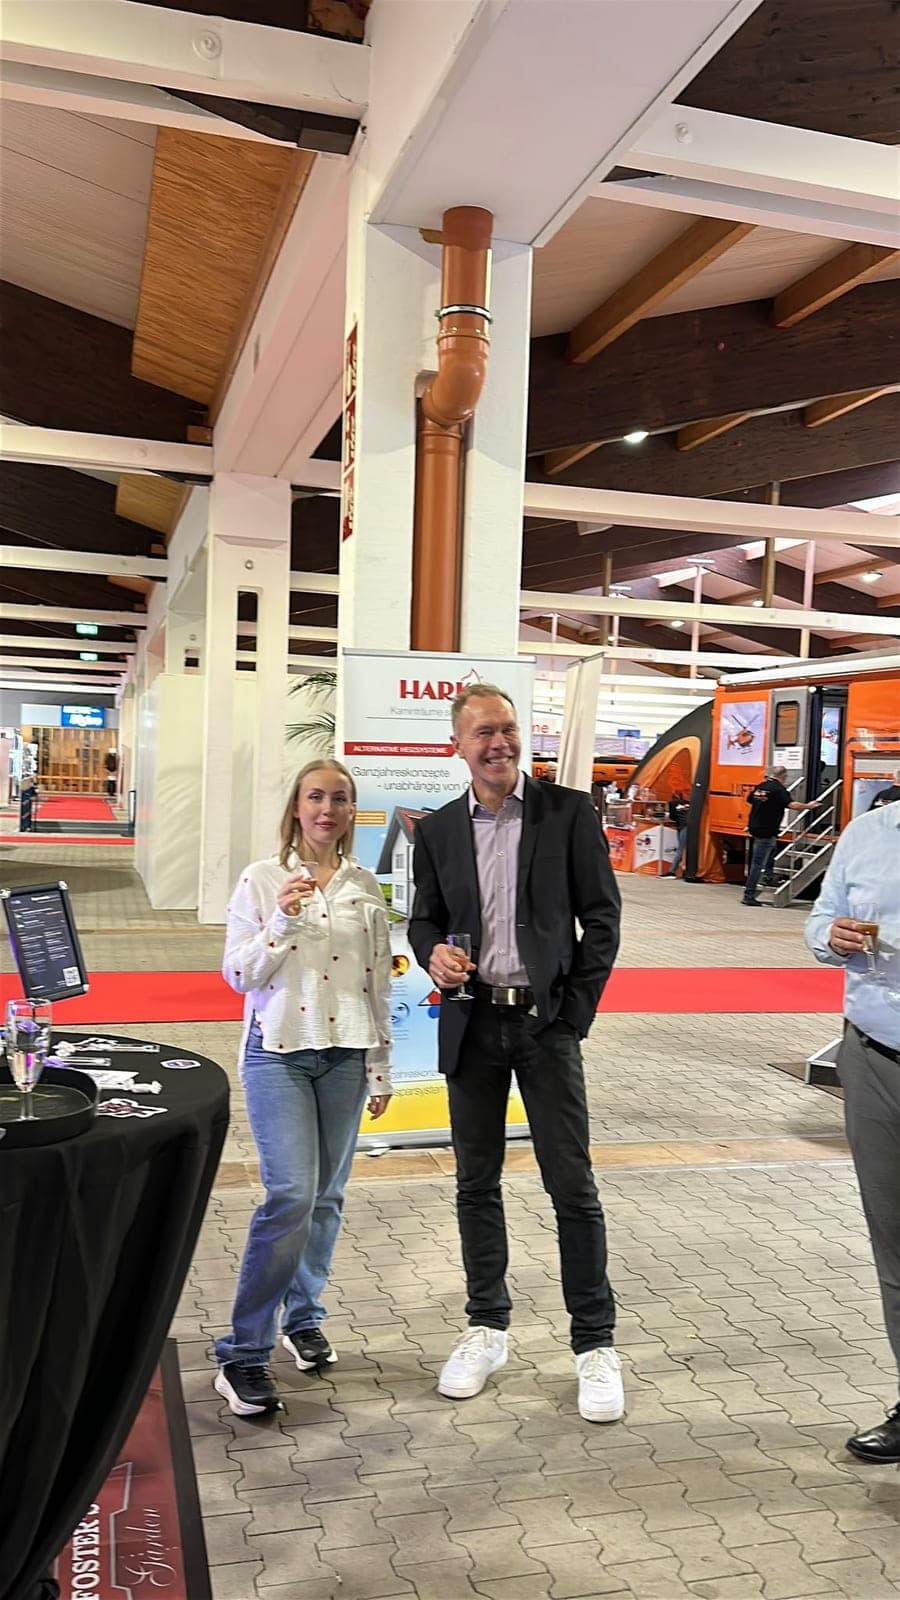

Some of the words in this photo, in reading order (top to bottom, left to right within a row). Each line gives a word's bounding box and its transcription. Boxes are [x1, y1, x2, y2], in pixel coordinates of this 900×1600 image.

[400, 680, 472, 702] HARK
[353, 745, 400, 753] ALTERNATIVE
[352, 766, 450, 779] Ganzjahreskonzepte
[384, 780, 440, 793] unabhängig
[444, 782, 460, 791] von
[124, 1508, 177, 1587] Garden
